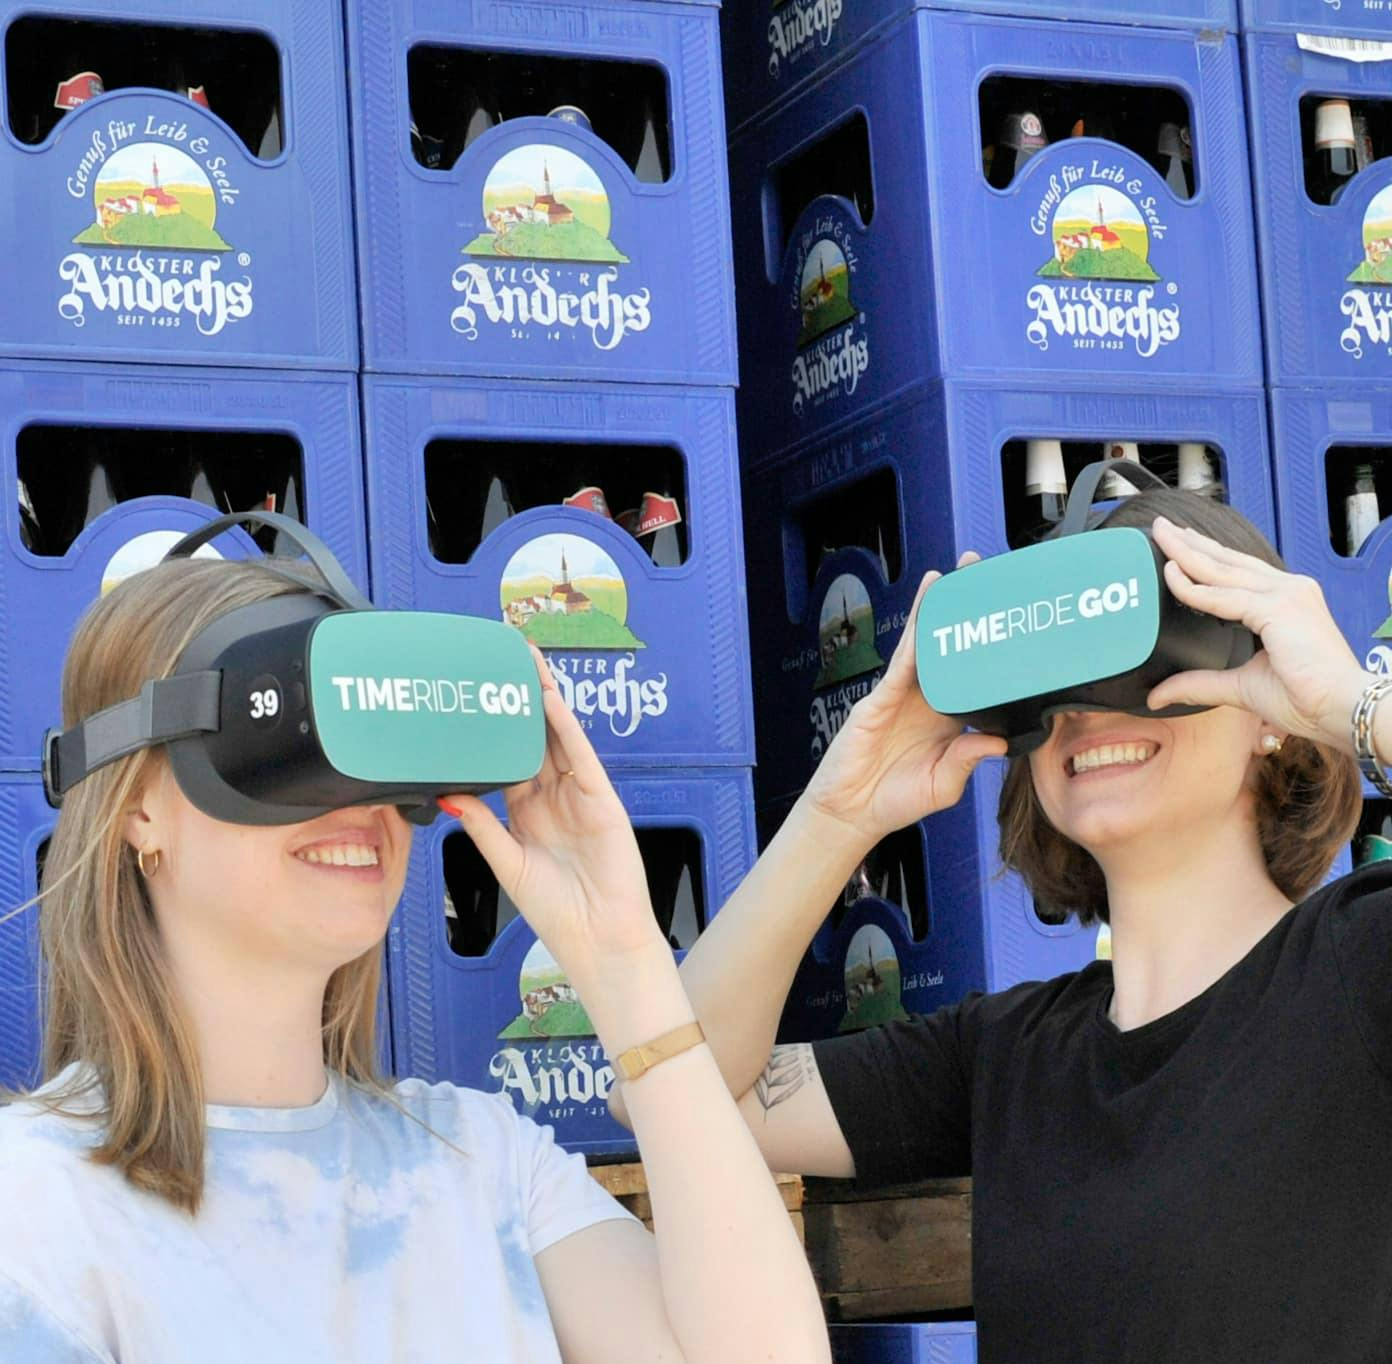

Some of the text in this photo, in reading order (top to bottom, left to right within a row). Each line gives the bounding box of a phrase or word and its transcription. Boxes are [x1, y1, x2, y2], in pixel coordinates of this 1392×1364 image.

[58, 250, 252, 335] Andechs
[101, 256, 194, 274] KLOSTER
[1060, 287, 1132, 302] KLOSTER
[451, 261, 650, 350] Andechs
[1027, 281, 1179, 356] Andechs
[933, 578, 1139, 657] TIMERIDE GO!
[250, 689, 279, 719] 39
[332, 677, 531, 716] TIMERIDE GO!
[489, 1041, 616, 1106] Ande
